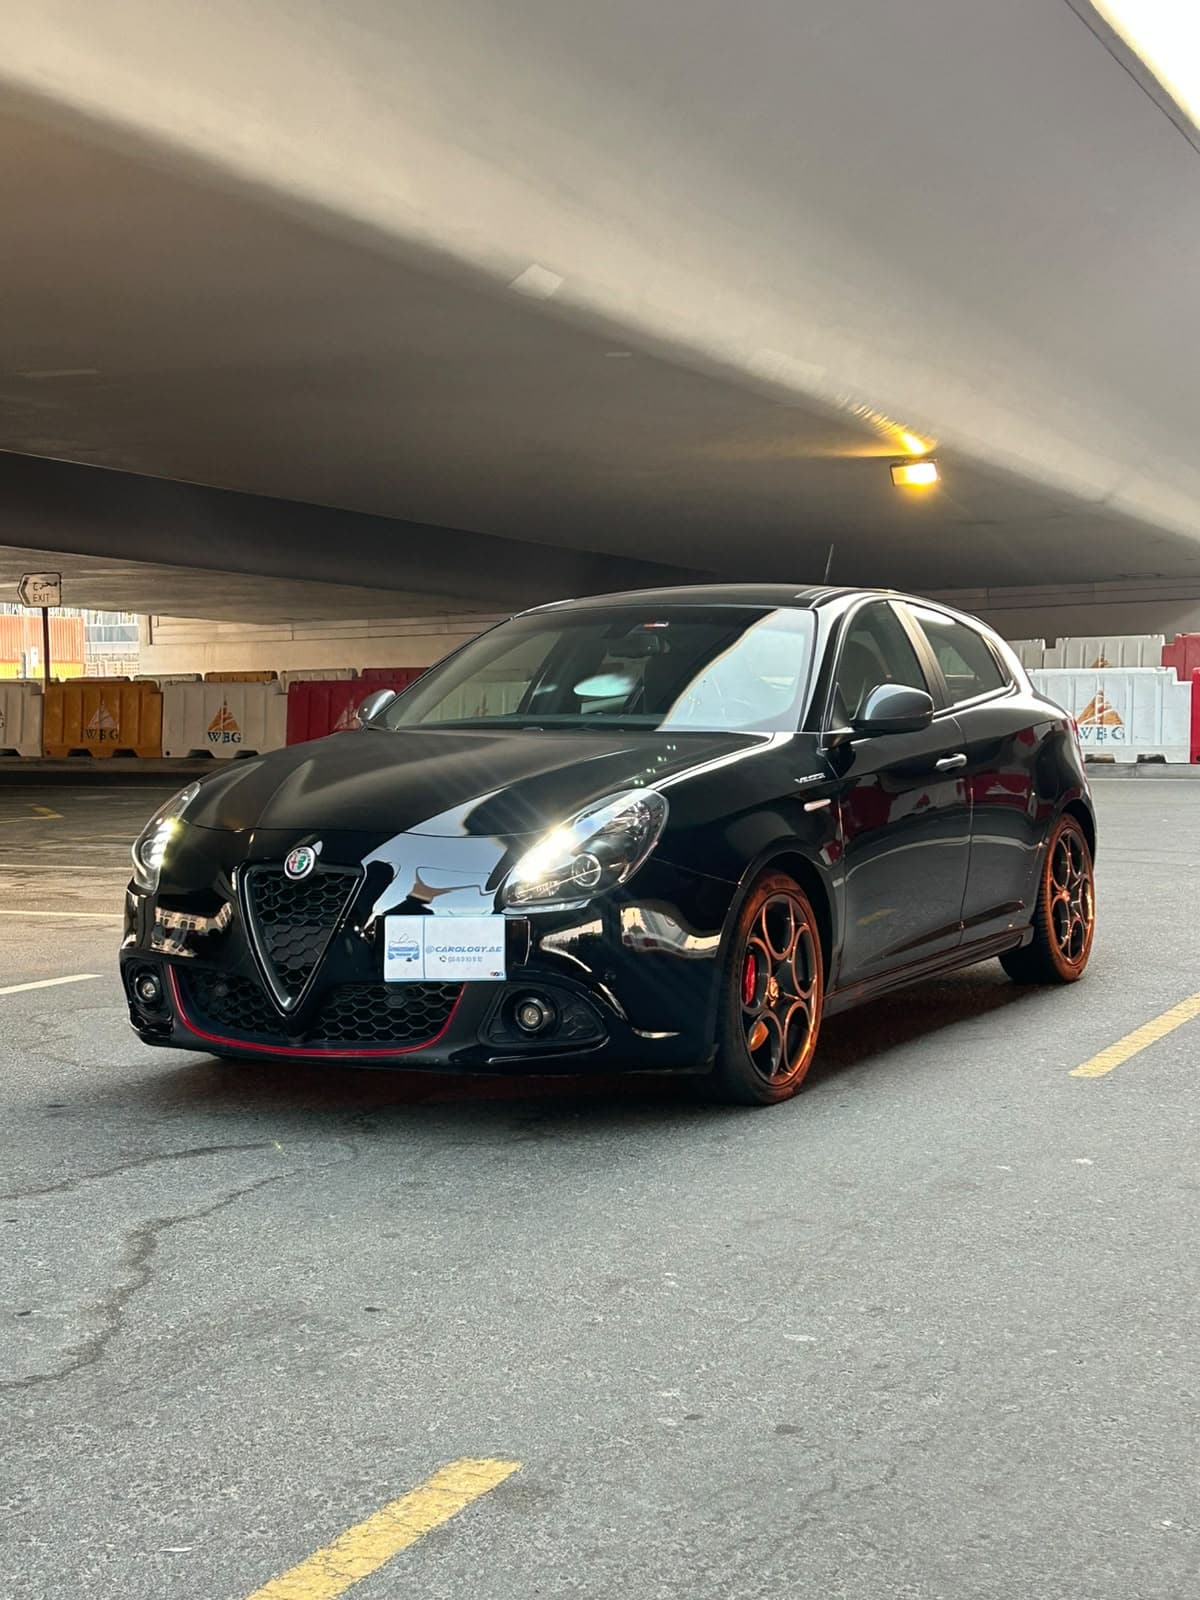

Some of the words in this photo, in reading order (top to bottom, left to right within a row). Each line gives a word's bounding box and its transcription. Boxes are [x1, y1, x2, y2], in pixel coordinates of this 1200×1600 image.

[33, 594, 50, 603] EXIT
[86, 728, 119, 741] WBG
[207, 731, 242, 744] WBG
[1079, 726, 1126, 741] WBG
